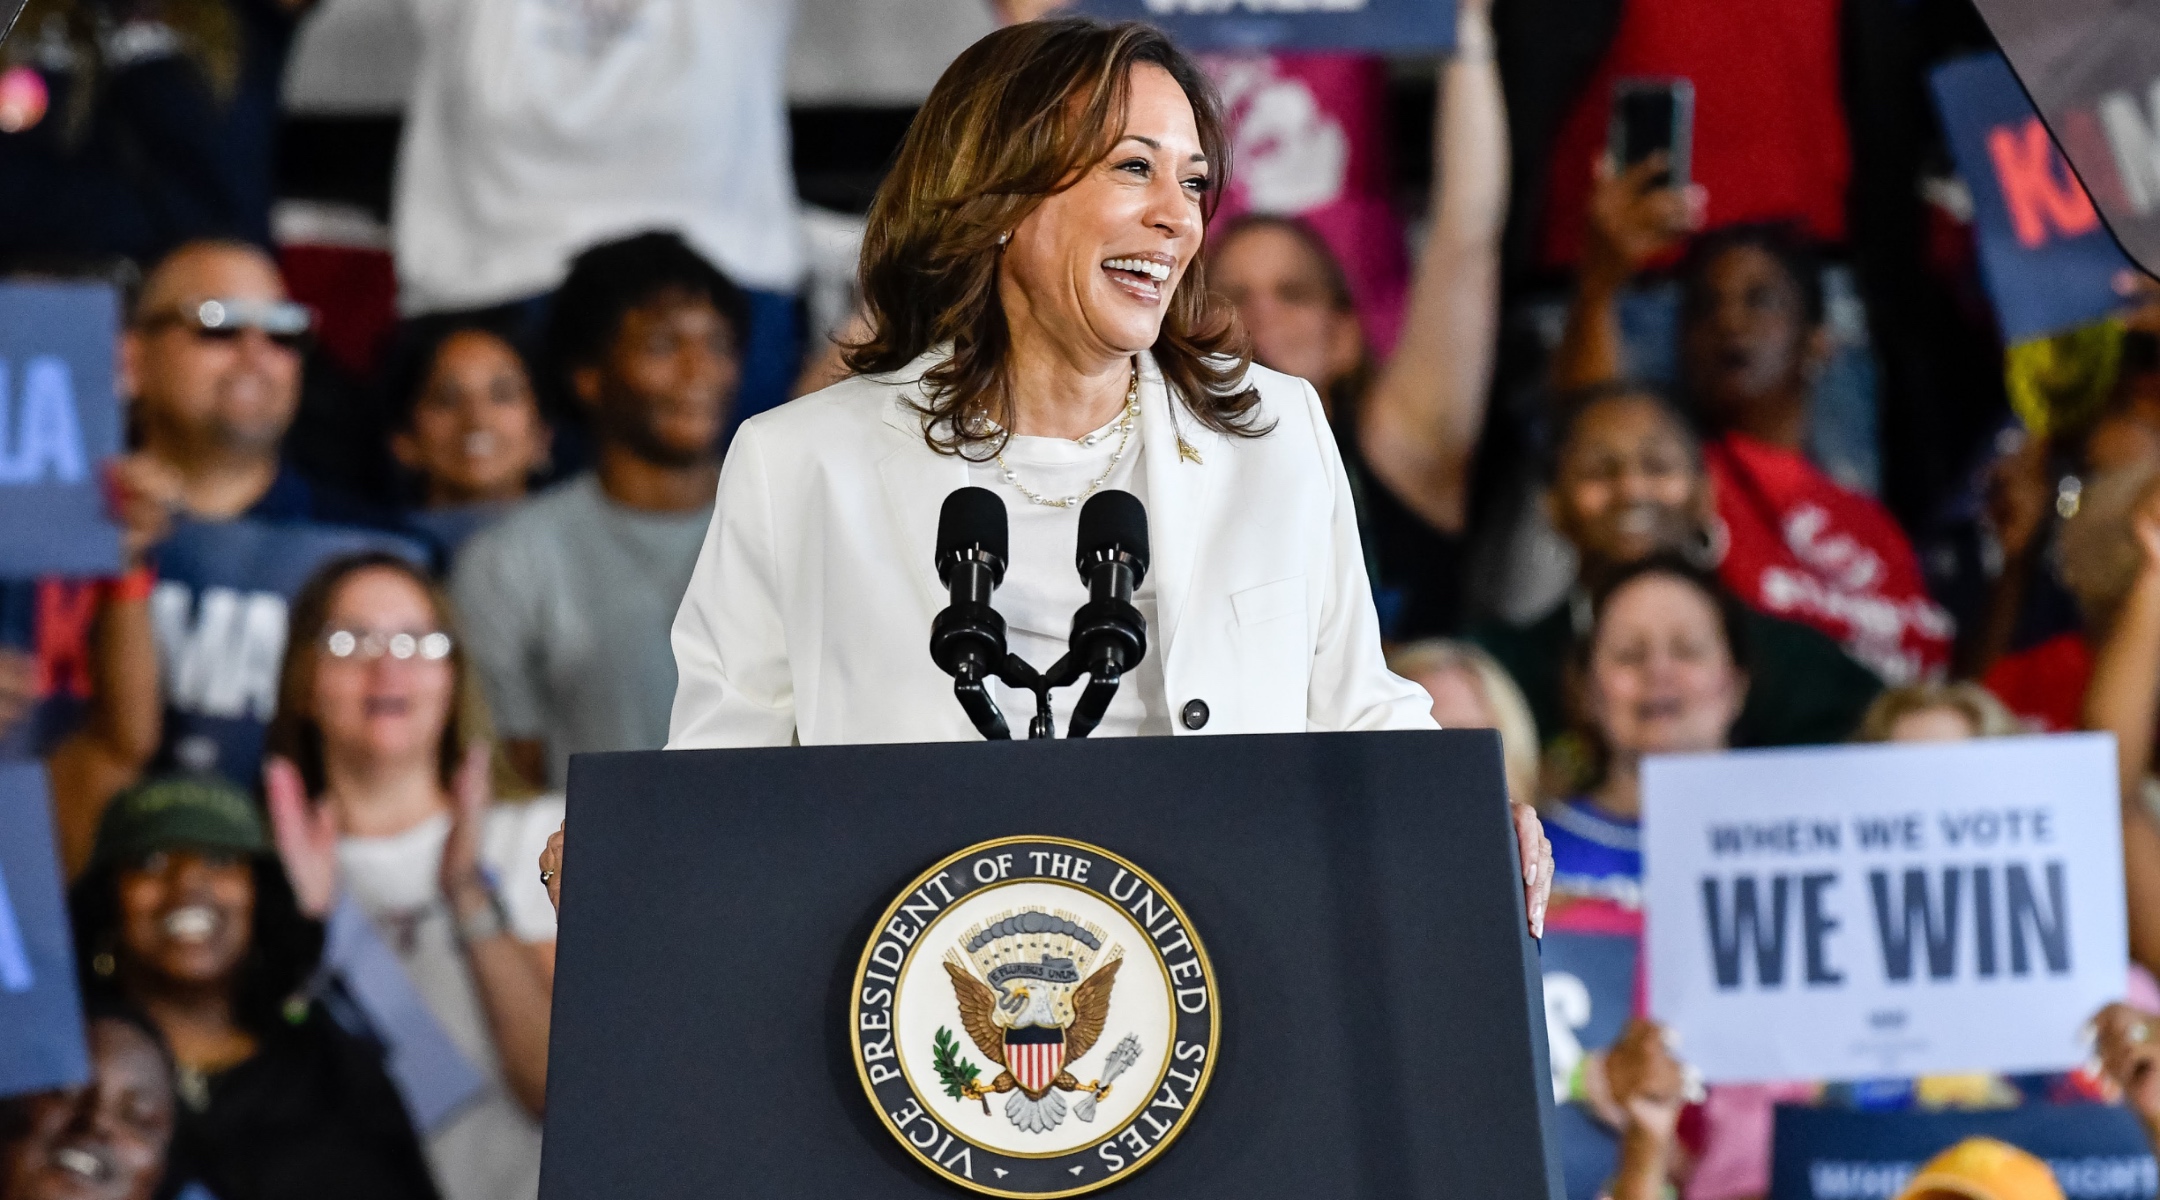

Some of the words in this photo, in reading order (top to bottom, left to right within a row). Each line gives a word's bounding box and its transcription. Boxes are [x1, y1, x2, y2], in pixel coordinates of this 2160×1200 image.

[973, 854, 1013, 883] OF
[1029, 852, 1092, 883] THE
[1709, 817, 1840, 853] WHEN
[1855, 811, 1922, 849] WE
[1938, 807, 2053, 846] VOTE
[1108, 868, 1207, 1014] UNITED
[1701, 872, 1843, 988] WE
[1868, 862, 2072, 981] WIN
[860, 872, 955, 1085] PRESIDENT
[991, 973, 1000, 982] E
[998, 965, 1044, 978] PLURIBUS
[1048, 970, 1077, 980] UNUM
[890, 1097, 974, 1180] VICE
[1099, 1040, 1206, 1172] STATES
